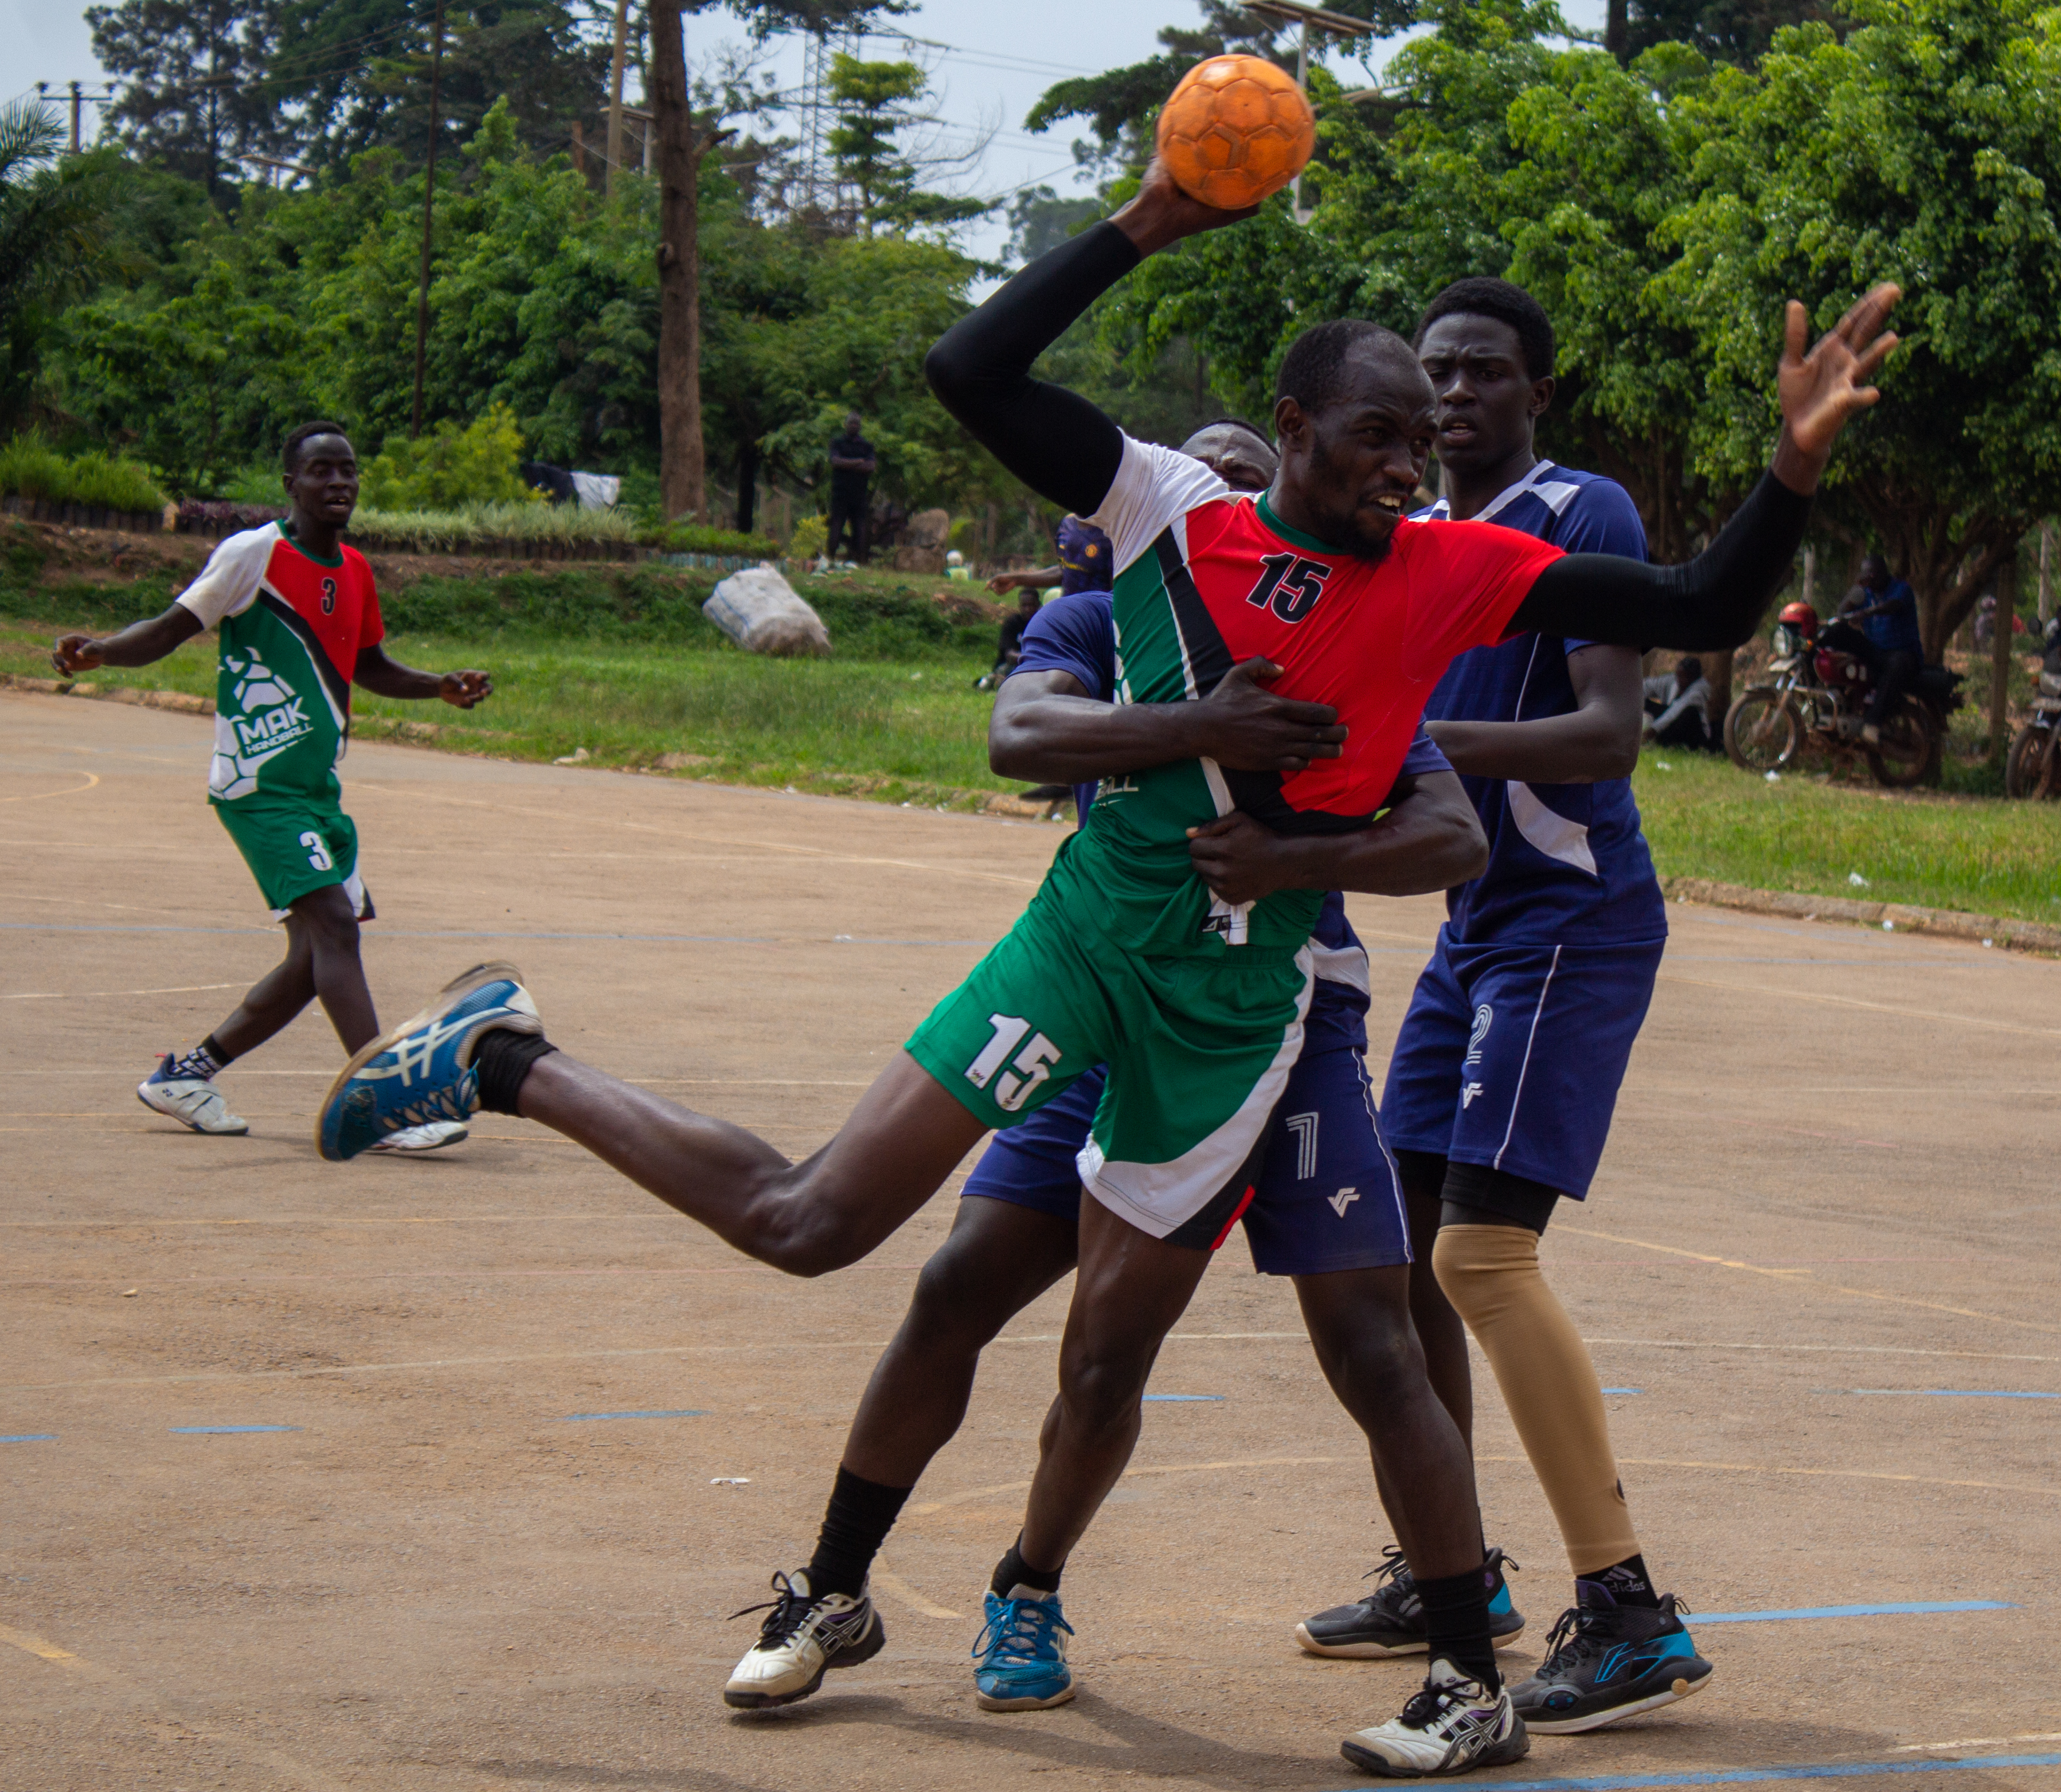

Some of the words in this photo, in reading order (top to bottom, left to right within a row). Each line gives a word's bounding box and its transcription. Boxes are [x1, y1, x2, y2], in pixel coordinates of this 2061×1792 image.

[321, 577, 337, 616] 3
[1246, 551, 1333, 624] 15
[237, 696, 310, 745] MAK
[245, 722, 314, 755] HANDBALL
[299, 831, 333, 871] 3
[1464, 1004, 1493, 1066] 2
[964, 1012, 1063, 1112] 15
[1285, 1112, 1319, 1180] 1
[1609, 1578, 1645, 1593] didas
